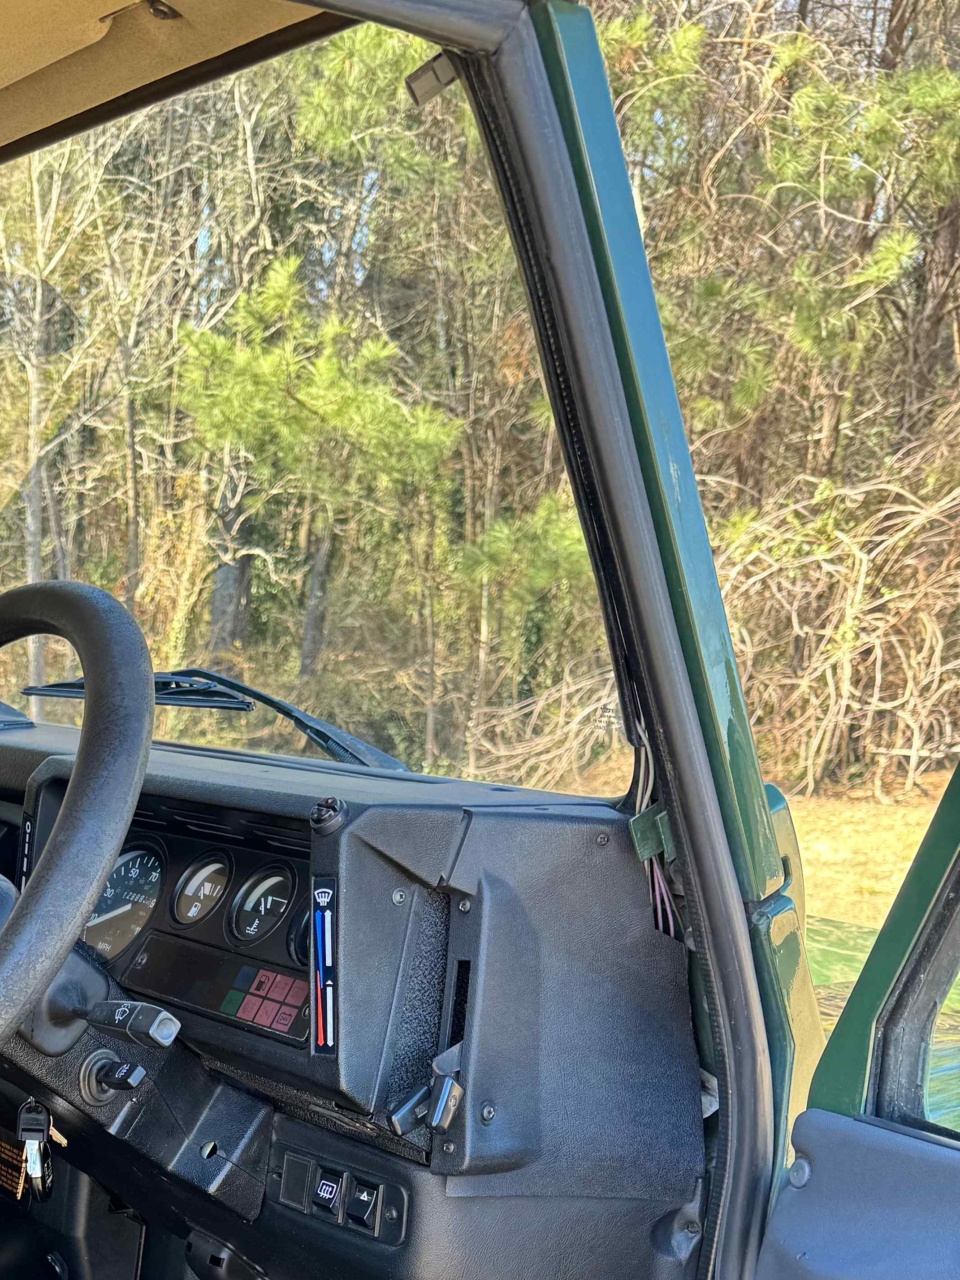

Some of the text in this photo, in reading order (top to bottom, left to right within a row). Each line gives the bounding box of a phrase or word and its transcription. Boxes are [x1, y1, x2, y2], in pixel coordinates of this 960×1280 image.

[128, 868, 139, 878] 50
[104, 888, 115, 897] 30
[97, 941, 111, 952] MPH
